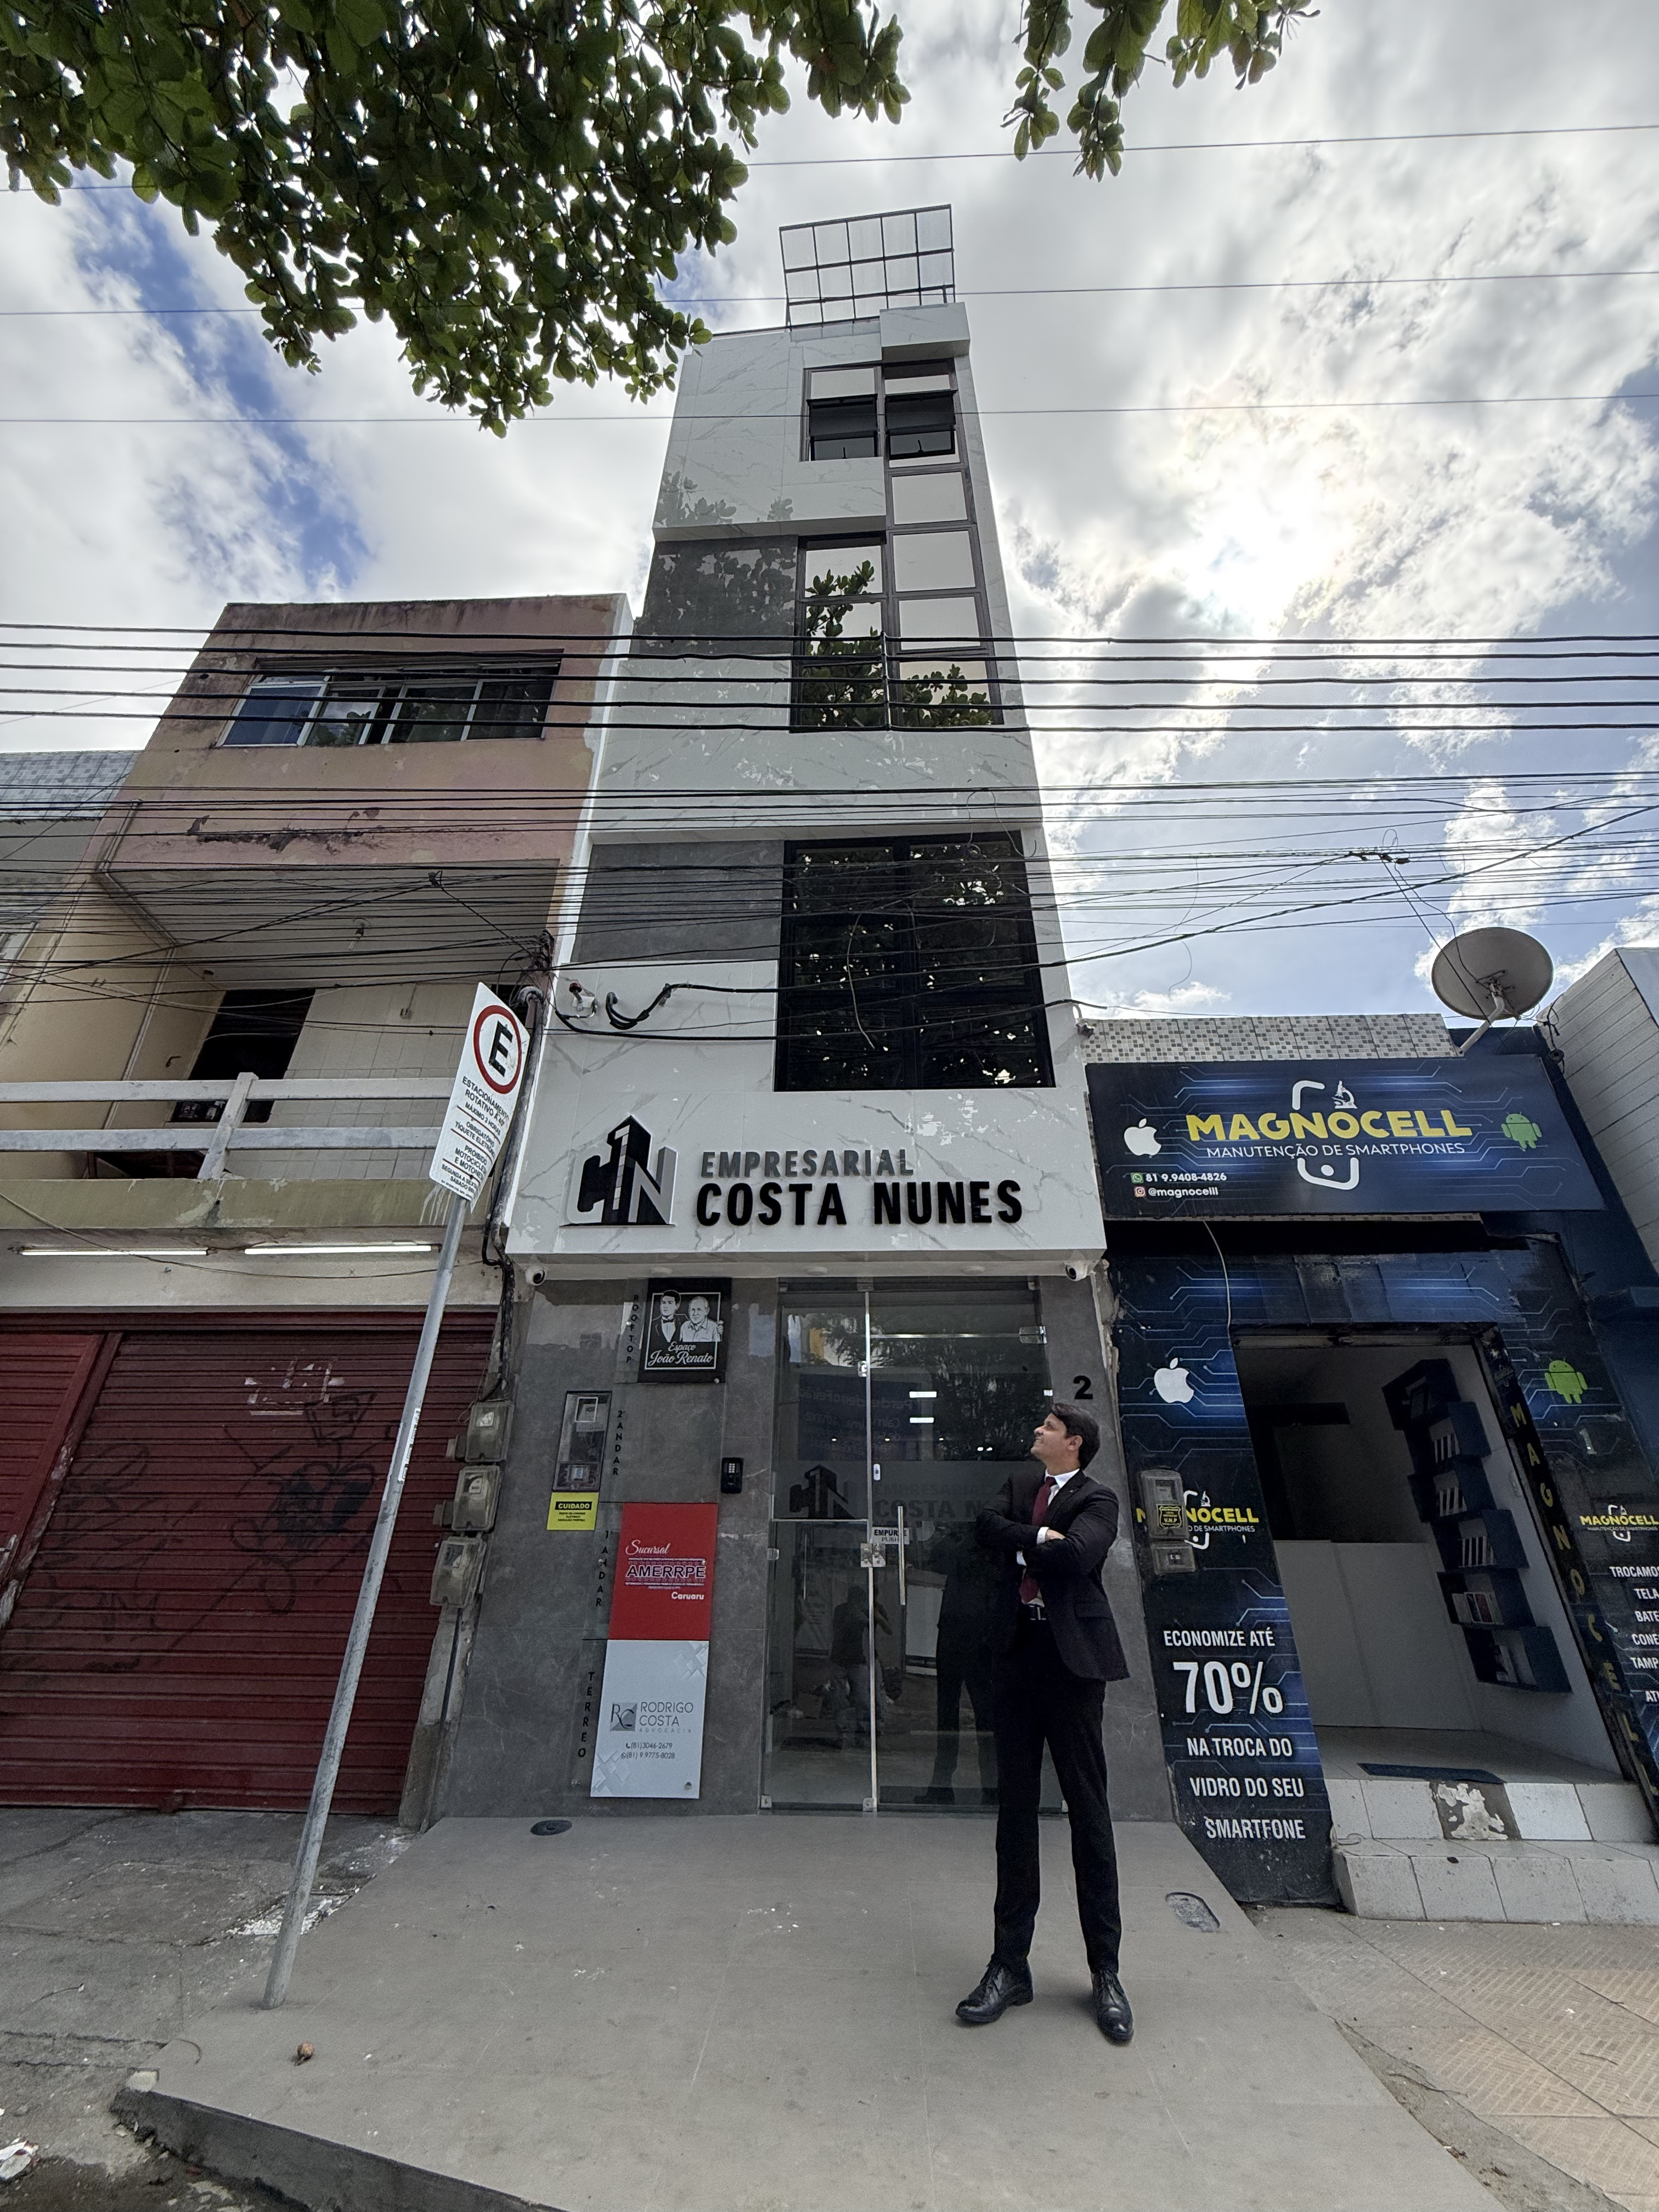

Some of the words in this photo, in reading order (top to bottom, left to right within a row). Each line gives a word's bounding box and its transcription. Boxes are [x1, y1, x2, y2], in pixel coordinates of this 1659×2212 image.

[488, 1020, 513, 1077] E
[462, 1076, 509, 1121] ESTACIONAMENTO
[465, 1089, 493, 1116] ROTATIVO
[465, 1102, 484, 1120] MÁXIMO
[488, 1120, 500, 1136] HORAS
[1186, 1110, 1472, 1141] MAGNOCELL
[455, 1121, 476, 1139] TÍQUETE
[465, 1145, 487, 1165] PROIBIDO
[1207, 1142, 1318, 1159] MANUTENÇÃO
[1324, 1144, 1343, 1156] DE
[1347, 1142, 1465, 1156] SMARTPHONES
[702, 1149, 915, 1178] EMPRESARIAL
[1146, 1173, 1158, 1182] 81
[1161, 1172, 1227, 1182] 9.9408-4826
[696, 1183, 847, 1226] COSTA
[873, 1180, 1022, 1224] NUNES
[627, 1295, 639, 1363] ROOFTOP
[668, 1341, 696, 1353] Espaço
[648, 1350, 675, 1366] João
[675, 1351, 714, 1364] Renato
[1073, 1375, 1093, 1400] 2
[613, 1421, 624, 1475] ANDAR
[1136, 1508, 1260, 1523] MNOCELL
[1579, 1515, 1659, 1525] MAGNOCELL
[625, 1539, 671, 1555] Sucursal
[625, 1565, 707, 1578] AMERRPE
[671, 1592, 704, 1600] Caruaru
[1633, 1588, 1659, 1599] TELA
[1635, 1611, 1659, 1622] BATE
[1163, 1630, 1246, 1646] ECONOMIZE
[1249, 1627, 1276, 1646] ATÉ
[1632, 1634, 1659, 1645] CONE
[1630, 1657, 1658, 1669] TAMP
[1173, 1661, 1283, 1714] 70%
[641, 1702, 693, 1713] RODRIGO
[639, 1715, 679, 1726] COSTA
[1187, 1737, 1209, 1756] NA
[1211, 1738, 1265, 1757] TROCA
[1269, 1738, 1293, 1757] DO
[1189, 1778, 1240, 1797] VIDRO
[1245, 1778, 1268, 1797] DO
[1273, 1778, 1305, 1797] SEU
[1205, 1819, 1306, 1839] SMARTFONE
